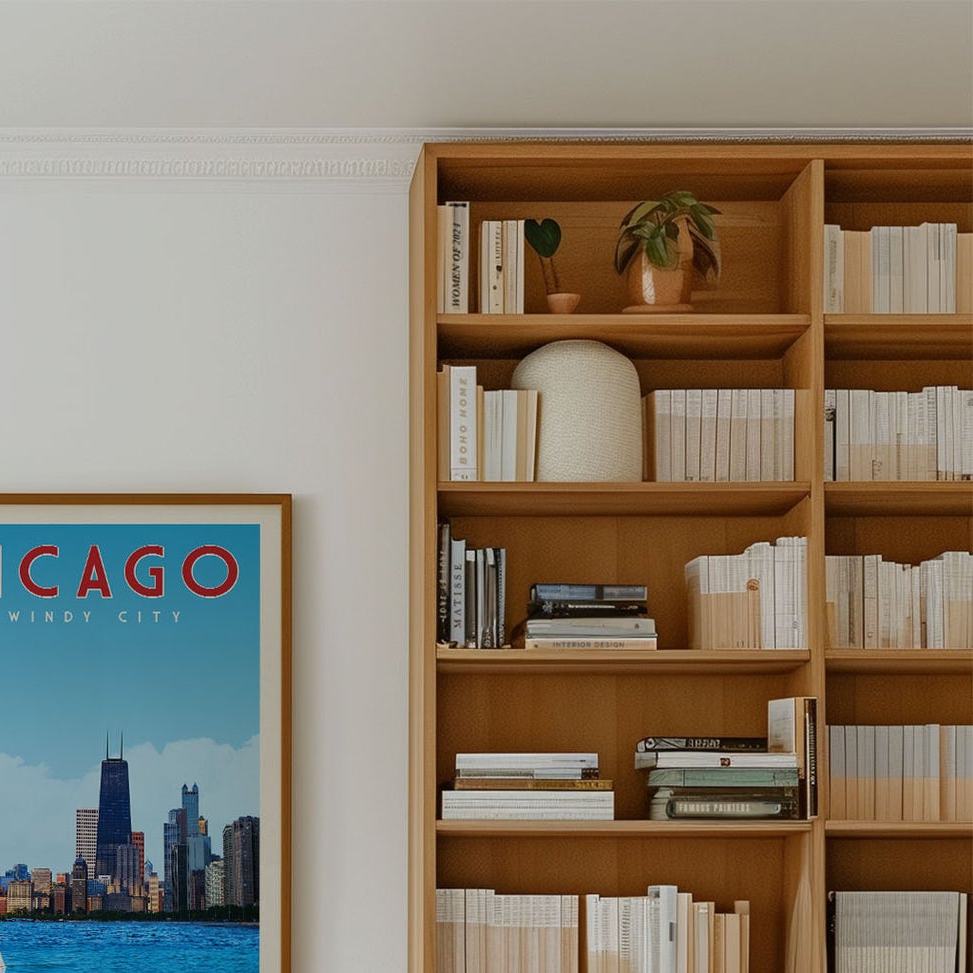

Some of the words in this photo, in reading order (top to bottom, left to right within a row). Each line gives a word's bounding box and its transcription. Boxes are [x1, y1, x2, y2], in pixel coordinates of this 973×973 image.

[452, 246, 461, 262] OF
[451, 263, 461, 307] WOMEN
[459, 377, 467, 418] HOME
[459, 425, 467, 465] BOHO
[453, 563, 462, 628] MATISSE
[8, 611, 92, 623] WINDY
[118, 611, 182, 623] CITY
